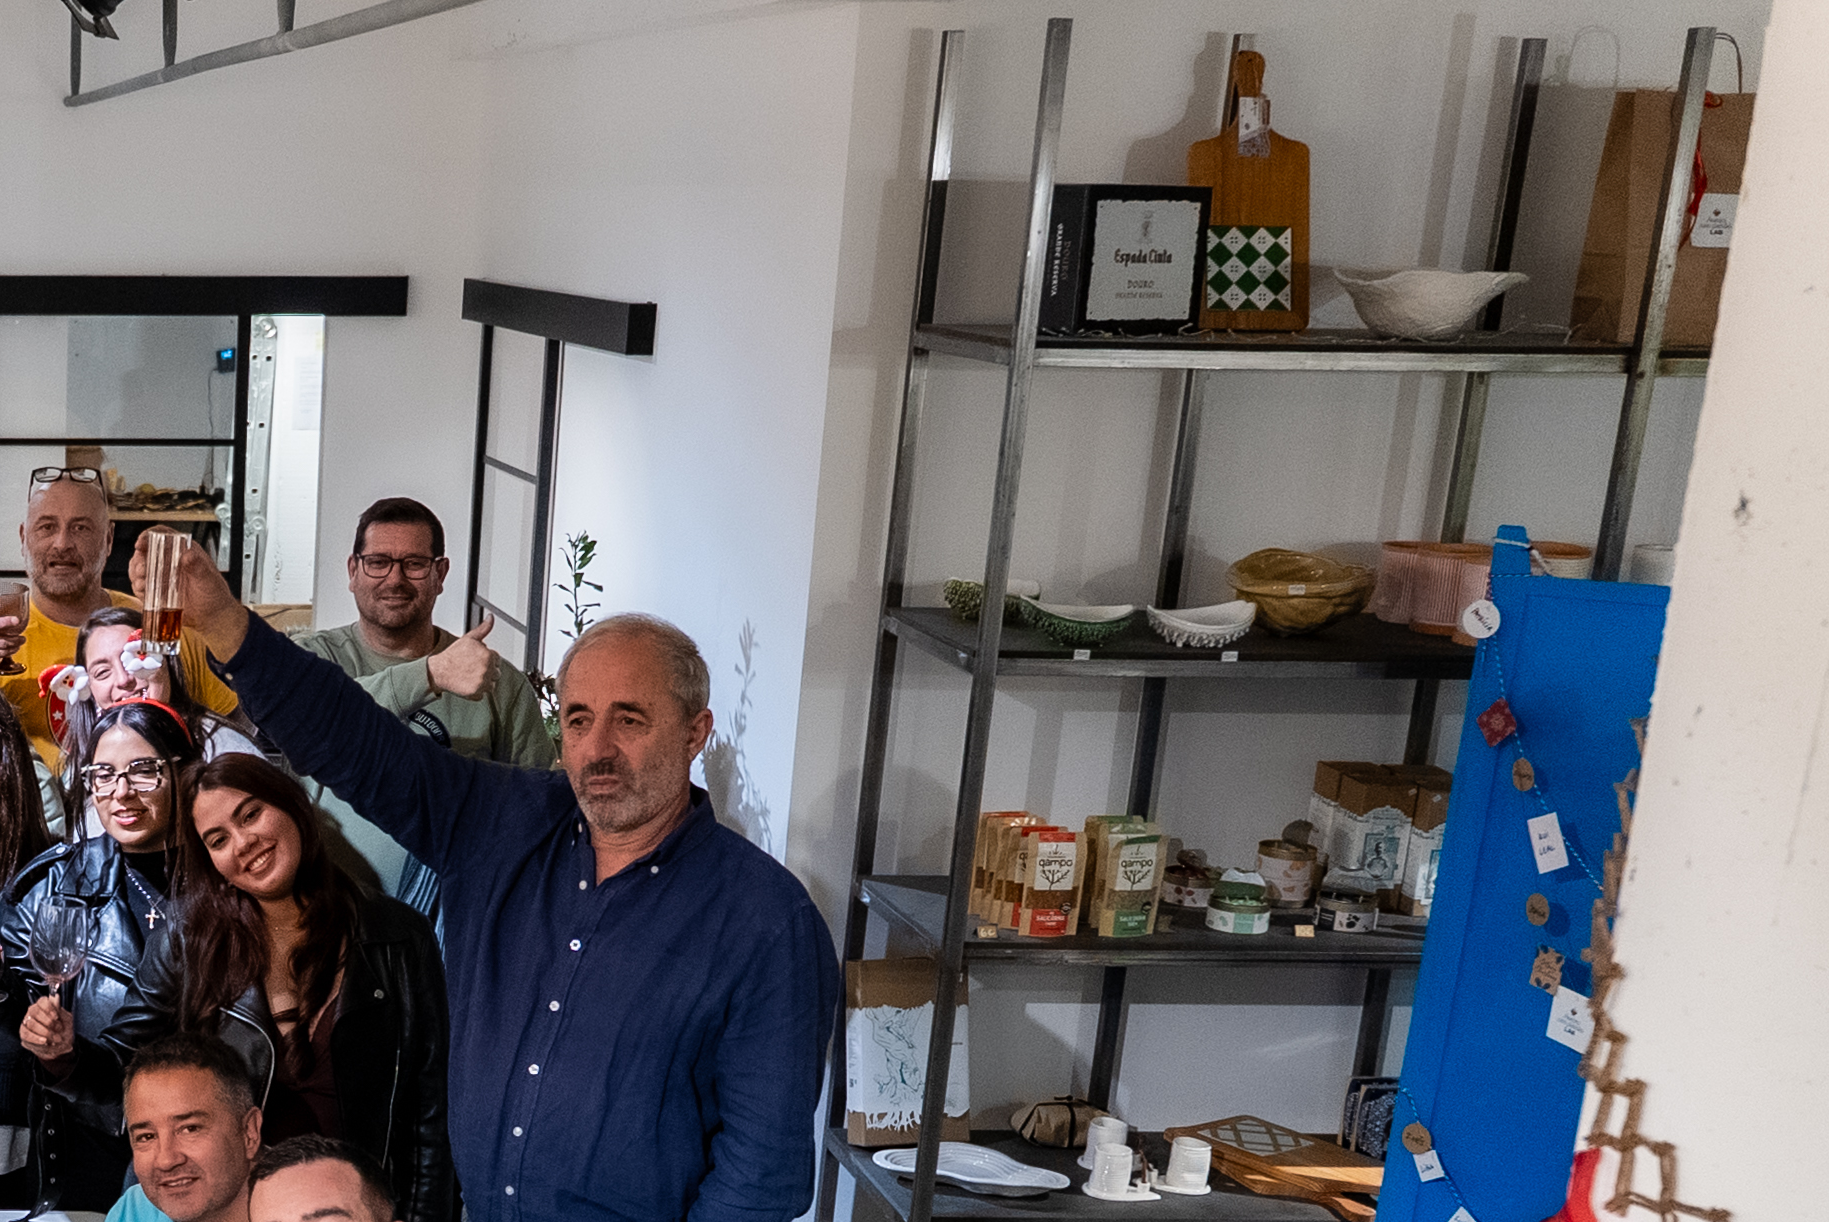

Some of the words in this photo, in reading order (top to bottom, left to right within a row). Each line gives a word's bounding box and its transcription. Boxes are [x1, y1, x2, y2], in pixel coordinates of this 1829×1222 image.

[1114, 247, 1148, 268] Espada
[1127, 279, 1155, 289] DOURO
[1038, 858, 1074, 868] qampo
[1120, 858, 1154, 869] qampo
